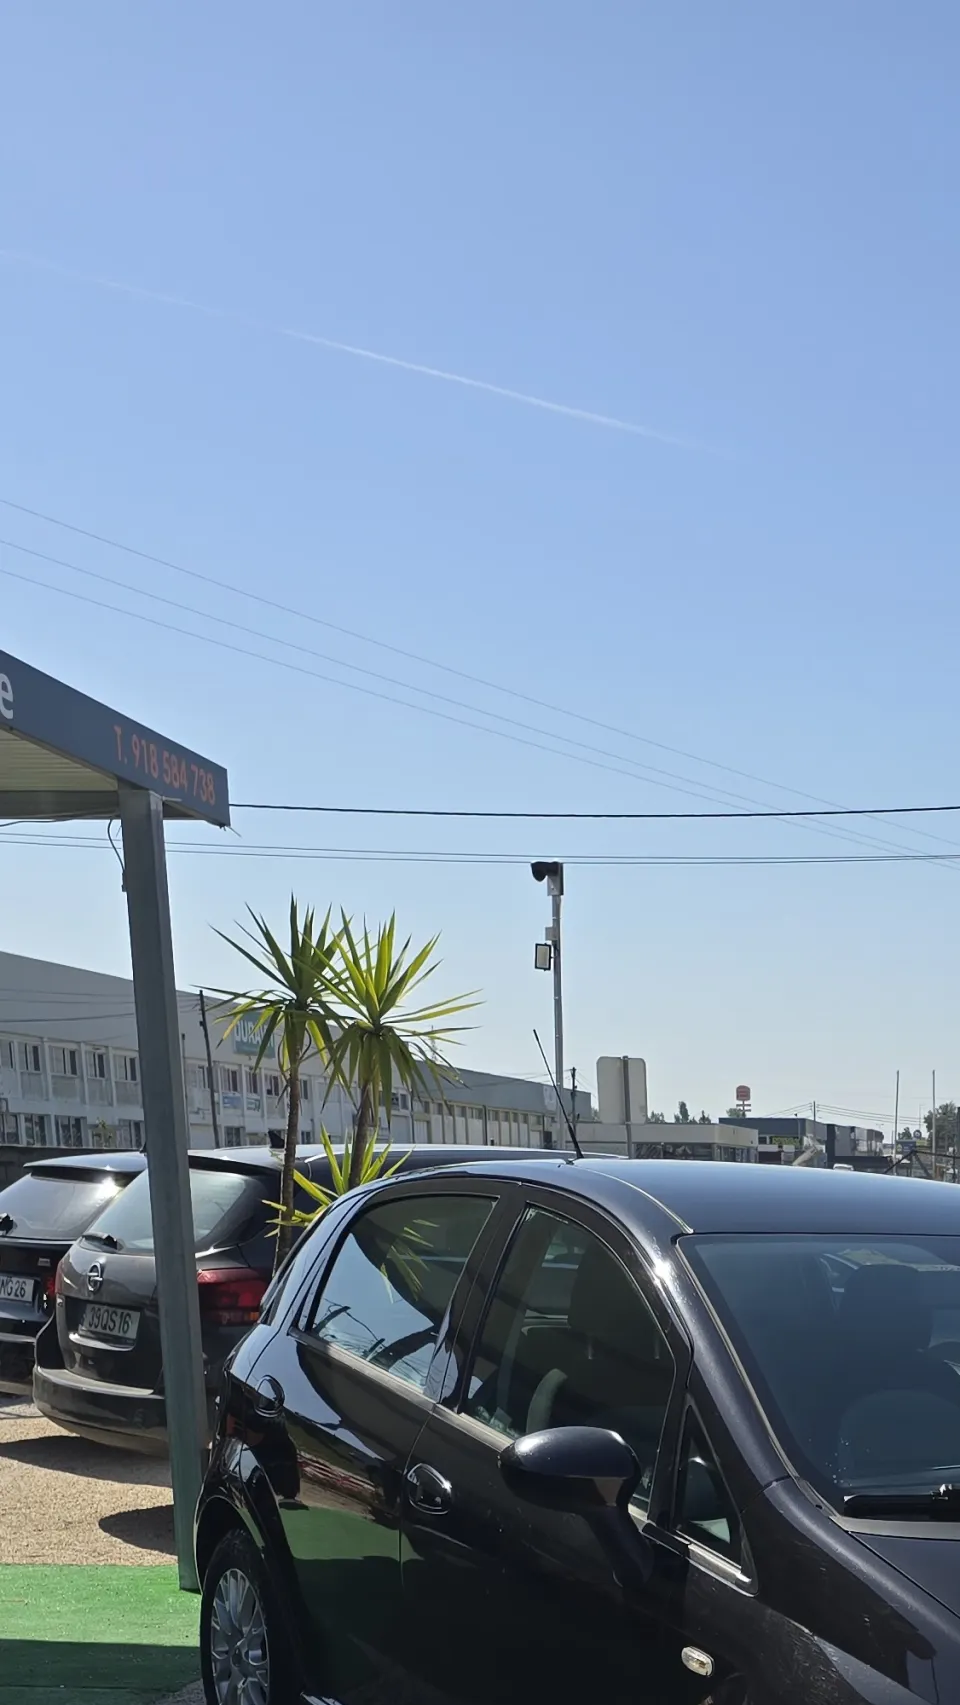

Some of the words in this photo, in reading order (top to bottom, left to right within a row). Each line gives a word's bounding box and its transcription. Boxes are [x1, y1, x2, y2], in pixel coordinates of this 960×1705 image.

[131, 733, 159, 780] 918
[163, 750, 188, 793] 584
[191, 763, 215, 807] 738
